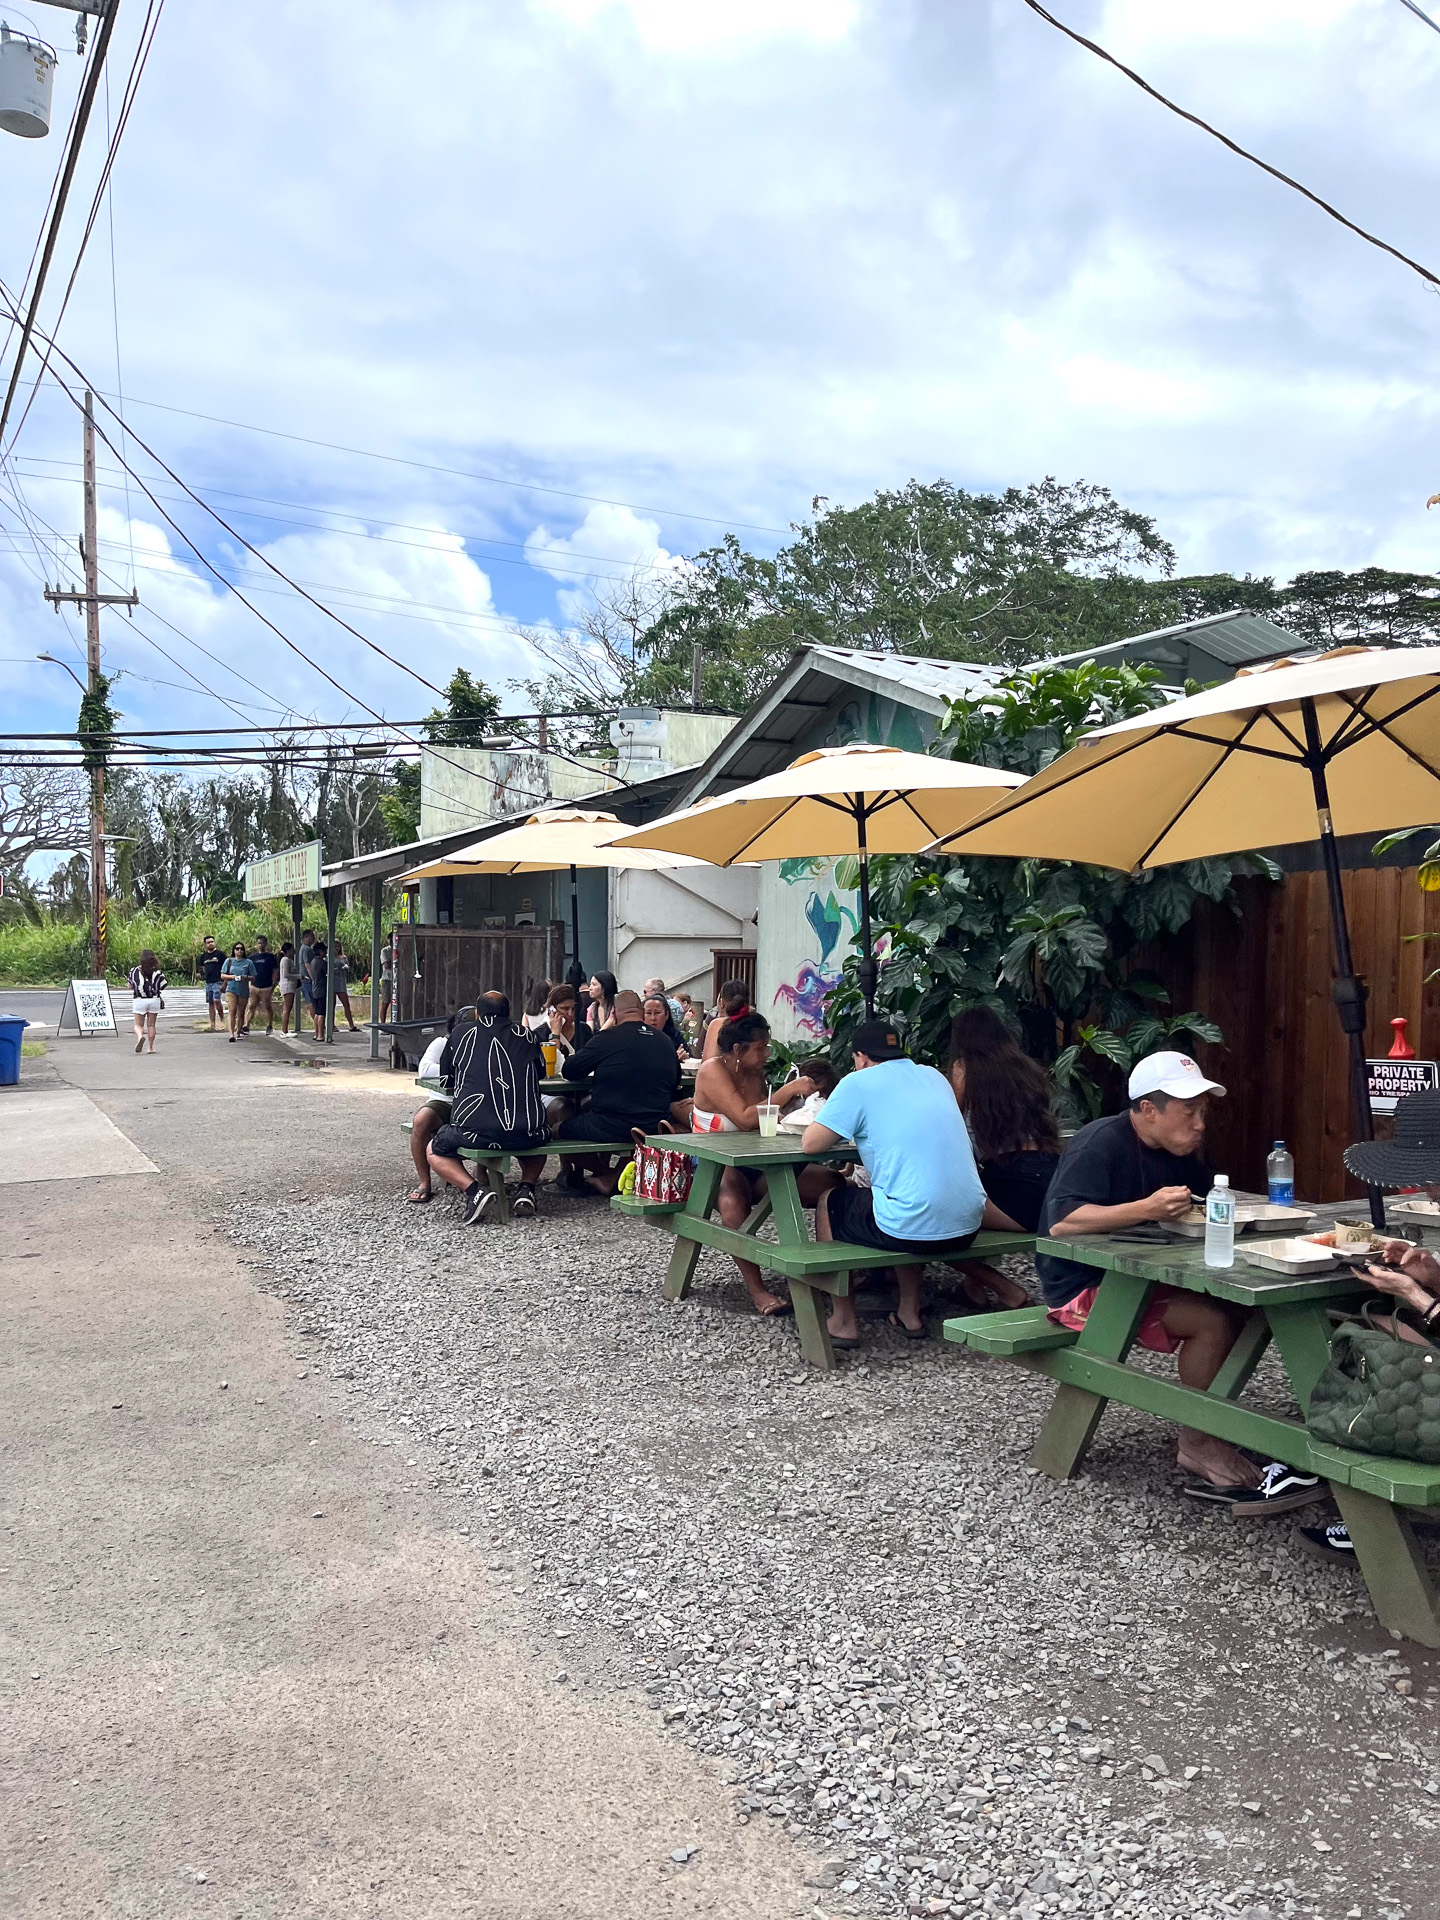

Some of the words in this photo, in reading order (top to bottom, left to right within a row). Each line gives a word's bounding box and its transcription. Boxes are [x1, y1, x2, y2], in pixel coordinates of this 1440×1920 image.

[285, 851, 307, 880] FACTORY
[1373, 1065, 1425, 1080] PRIVATE
[1368, 1077, 1431, 1092] PROPERTY
